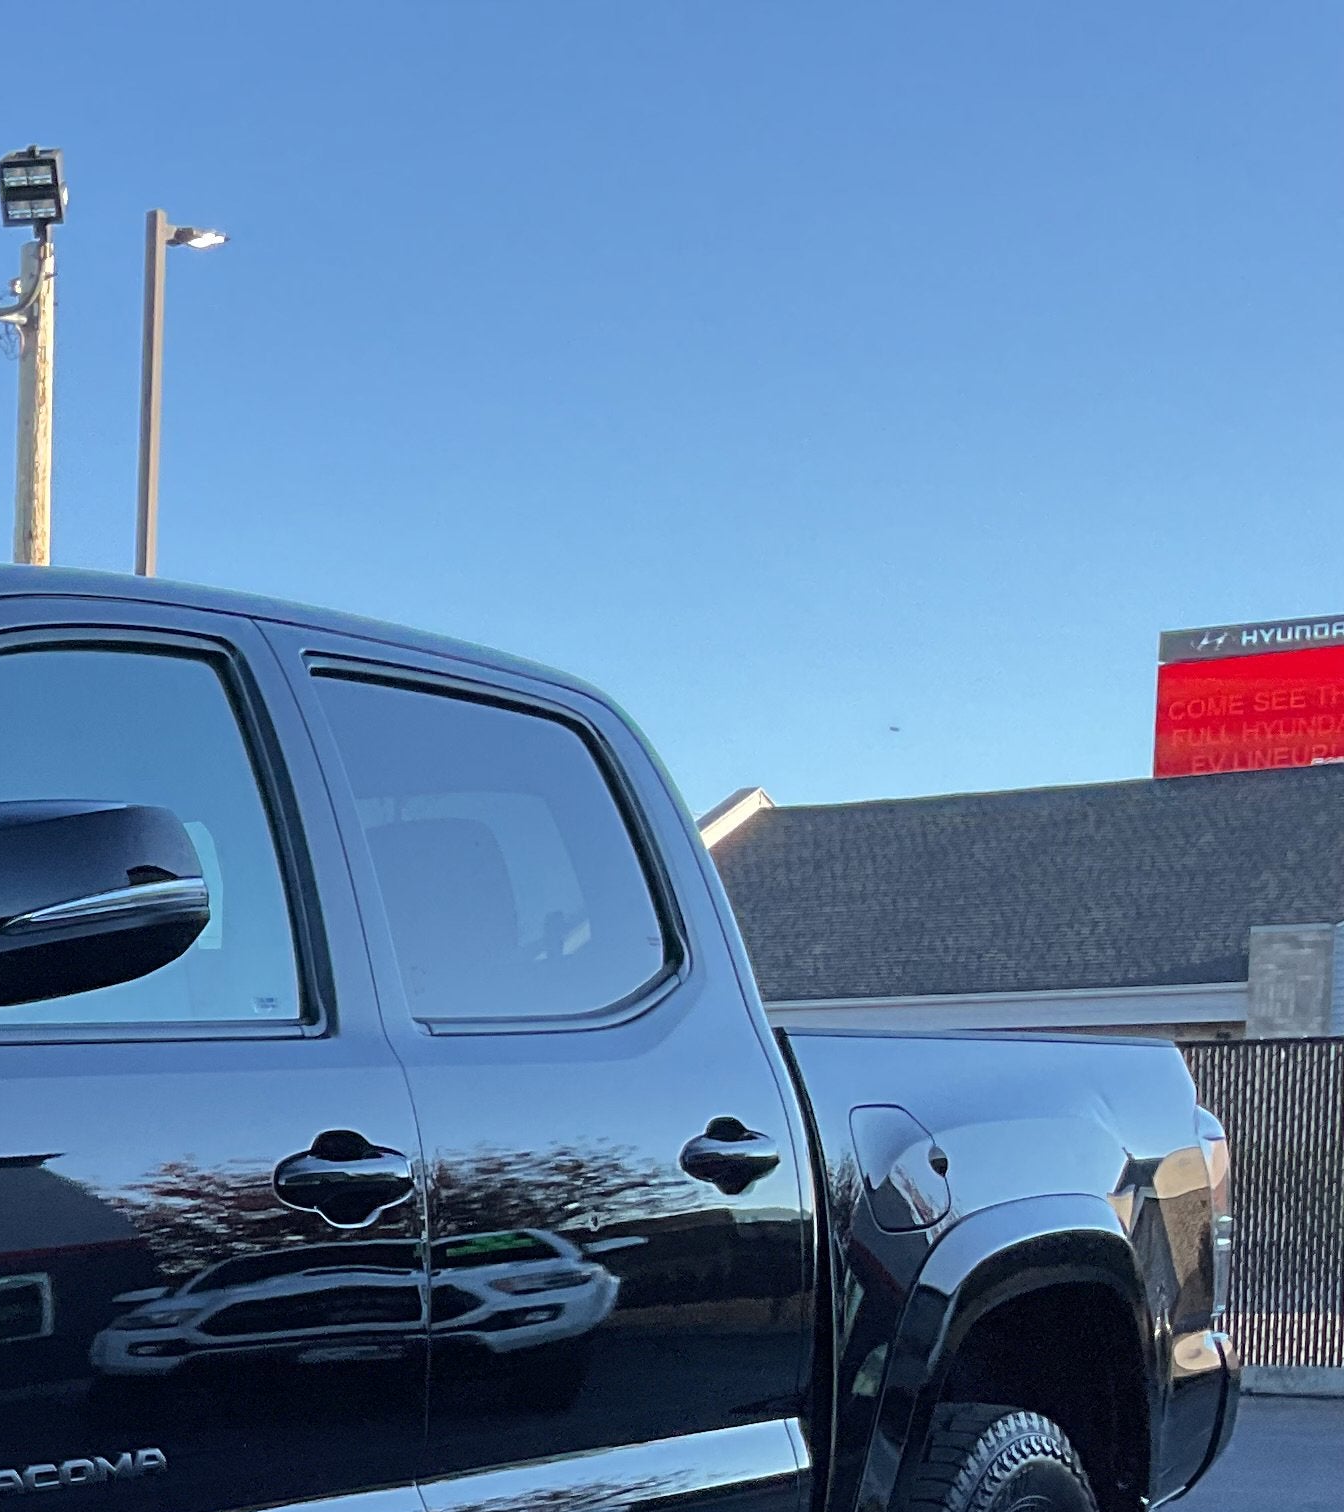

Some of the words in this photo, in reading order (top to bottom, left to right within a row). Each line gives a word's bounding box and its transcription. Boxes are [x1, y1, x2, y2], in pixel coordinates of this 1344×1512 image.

[1241, 621, 1344, 646] HYUNDA
[1168, 695, 1244, 720] COME
[1253, 687, 1306, 712] SEE
[1318, 683, 1344, 706] TH
[1171, 725, 1232, 748] FULL
[1242, 713, 1344, 744] HYUNDA
